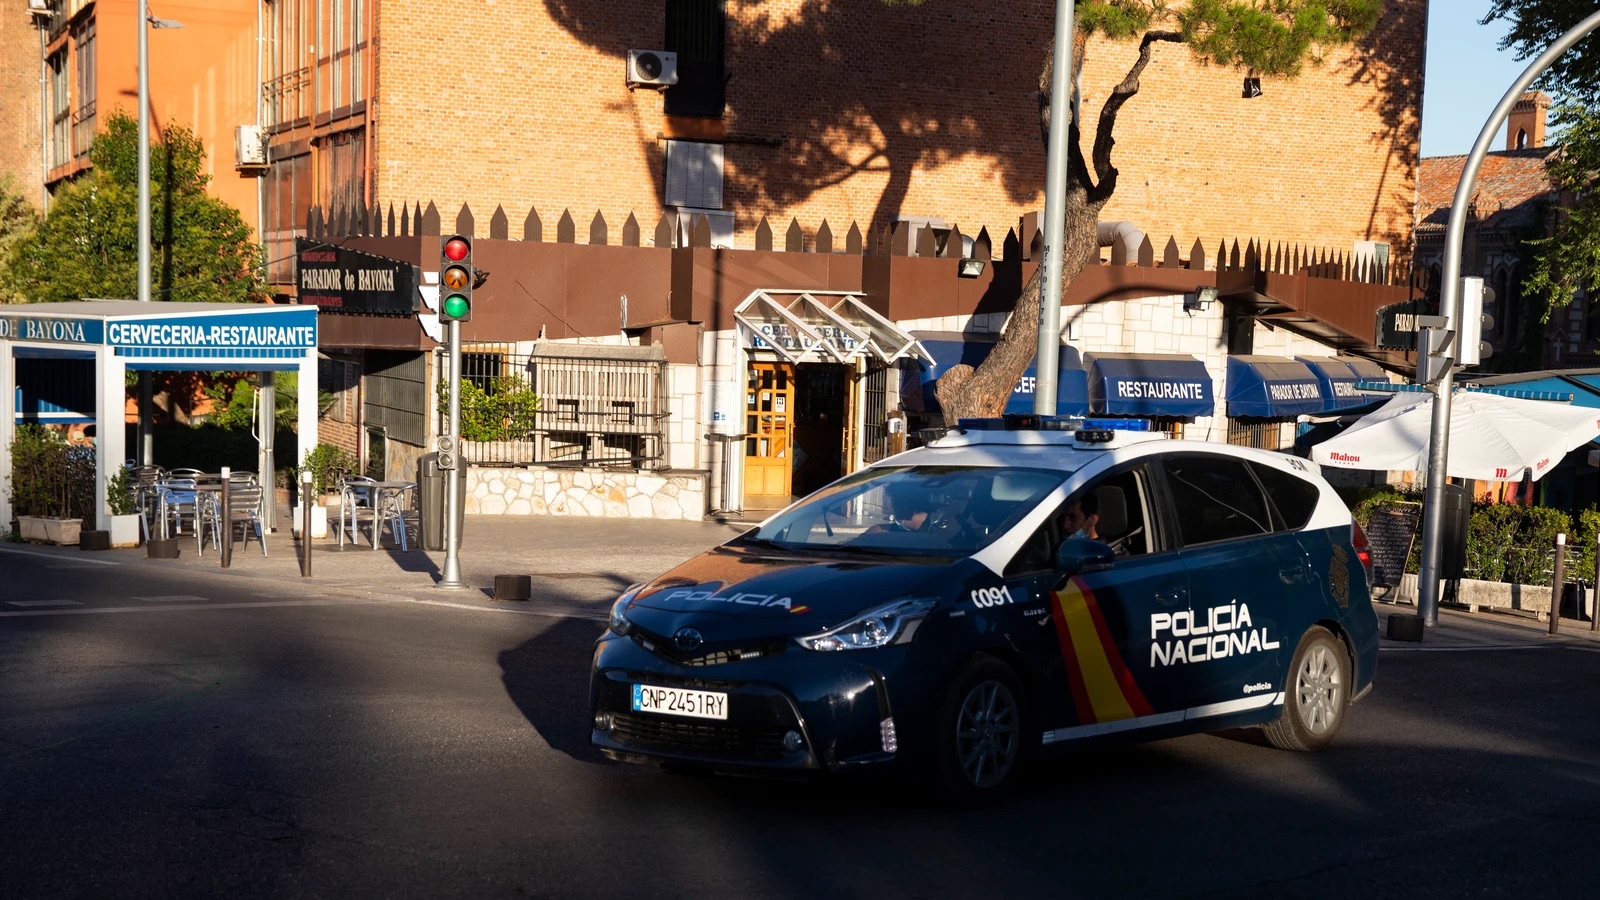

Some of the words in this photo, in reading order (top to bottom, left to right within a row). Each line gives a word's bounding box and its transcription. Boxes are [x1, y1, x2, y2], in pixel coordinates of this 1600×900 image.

[302, 269, 341, 290] PARADOR
[344, 270, 354, 290] de
[358, 269, 394, 291] BAYONA
[0, 319, 17, 337] DE
[26, 319, 86, 342] BAYONA
[109, 324, 314, 346] CERVECERIA-RESTAURANTE
[1117, 380, 1203, 399] RESTAURANTE
[1270, 385, 1294, 400] PARADOR
[1292, 384, 1302, 399] DE
[1299, 383, 1320, 399] BAYONA
[1330, 452, 1360, 462] Mahou
[664, 590, 792, 609] POLICÍA
[1151, 598, 1252, 639] POLICÍA
[1150, 627, 1280, 667] NACIONAL
